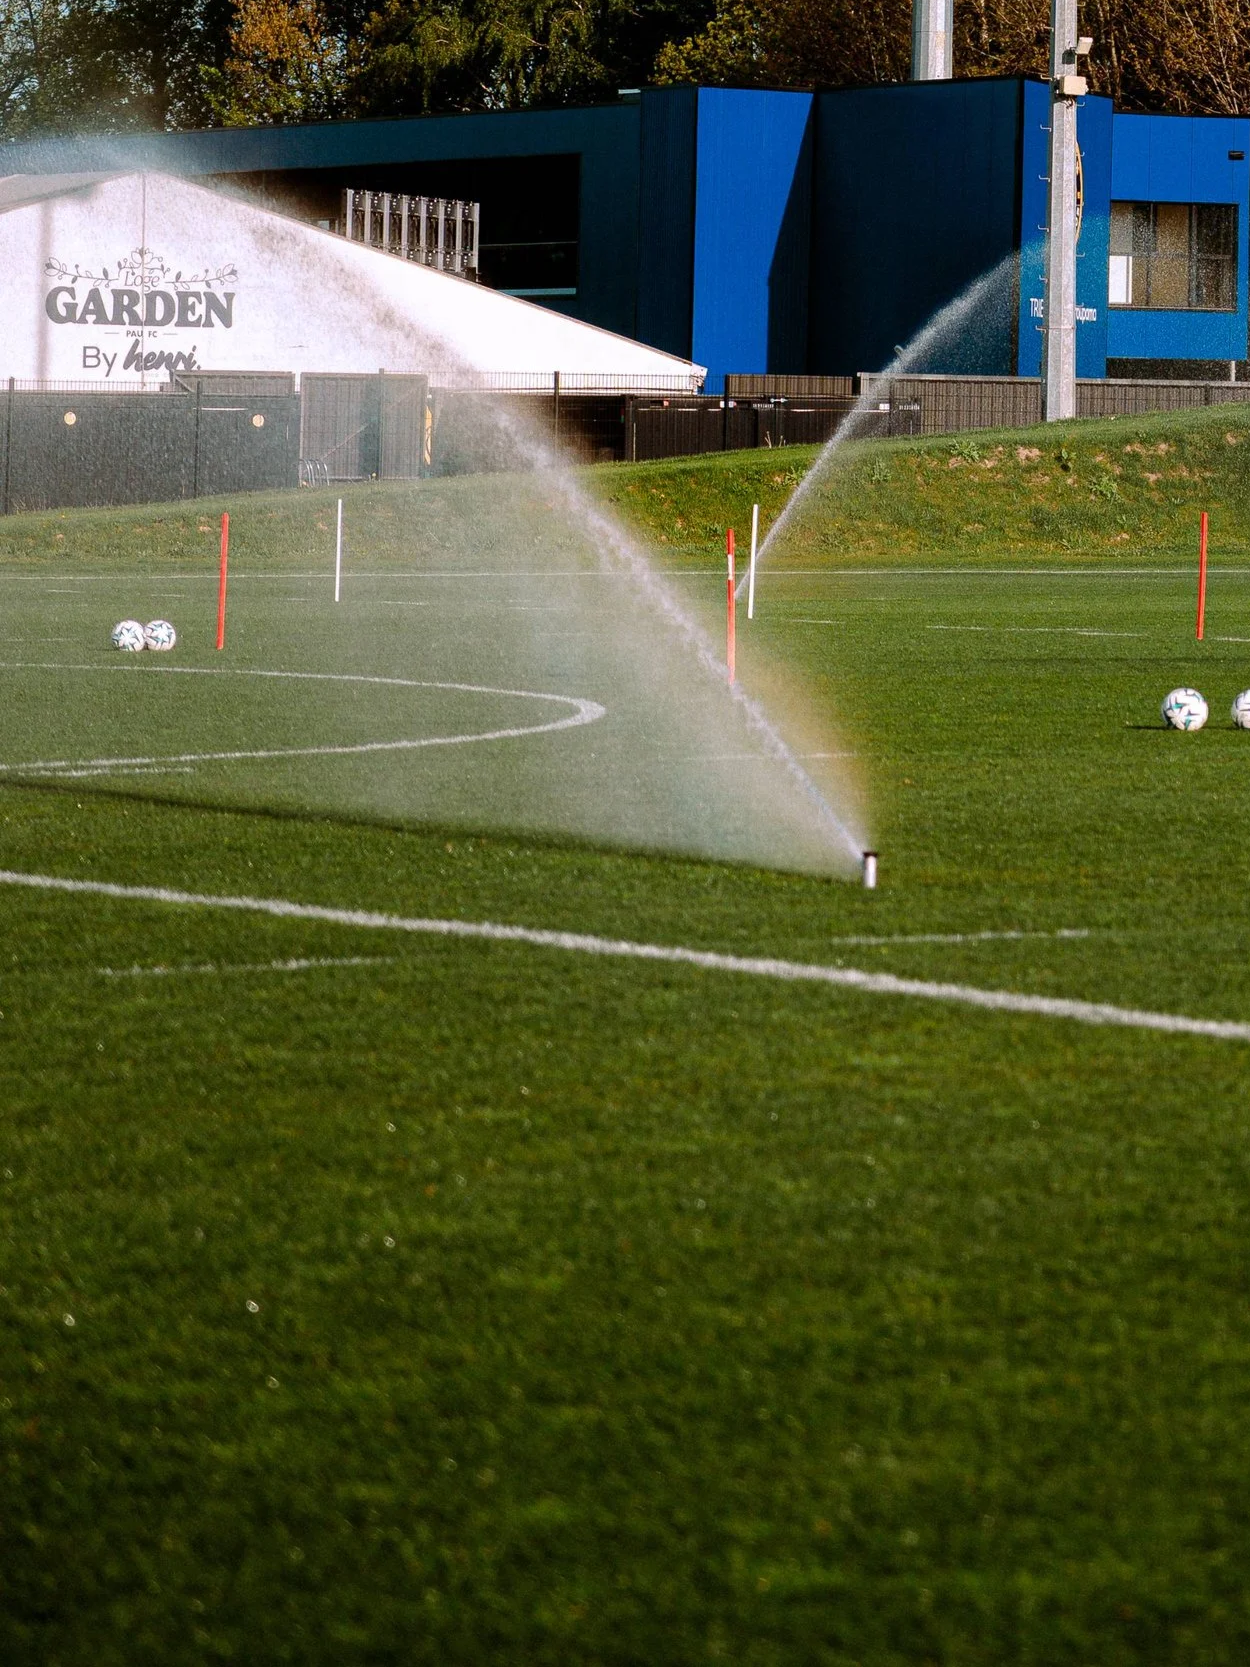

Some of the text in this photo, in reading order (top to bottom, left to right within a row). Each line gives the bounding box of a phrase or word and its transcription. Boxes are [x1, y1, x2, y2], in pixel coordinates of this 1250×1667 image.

[124, 271, 160, 292] Loge
[45, 286, 236, 328] GARDEN
[82, 346, 117, 377] By
